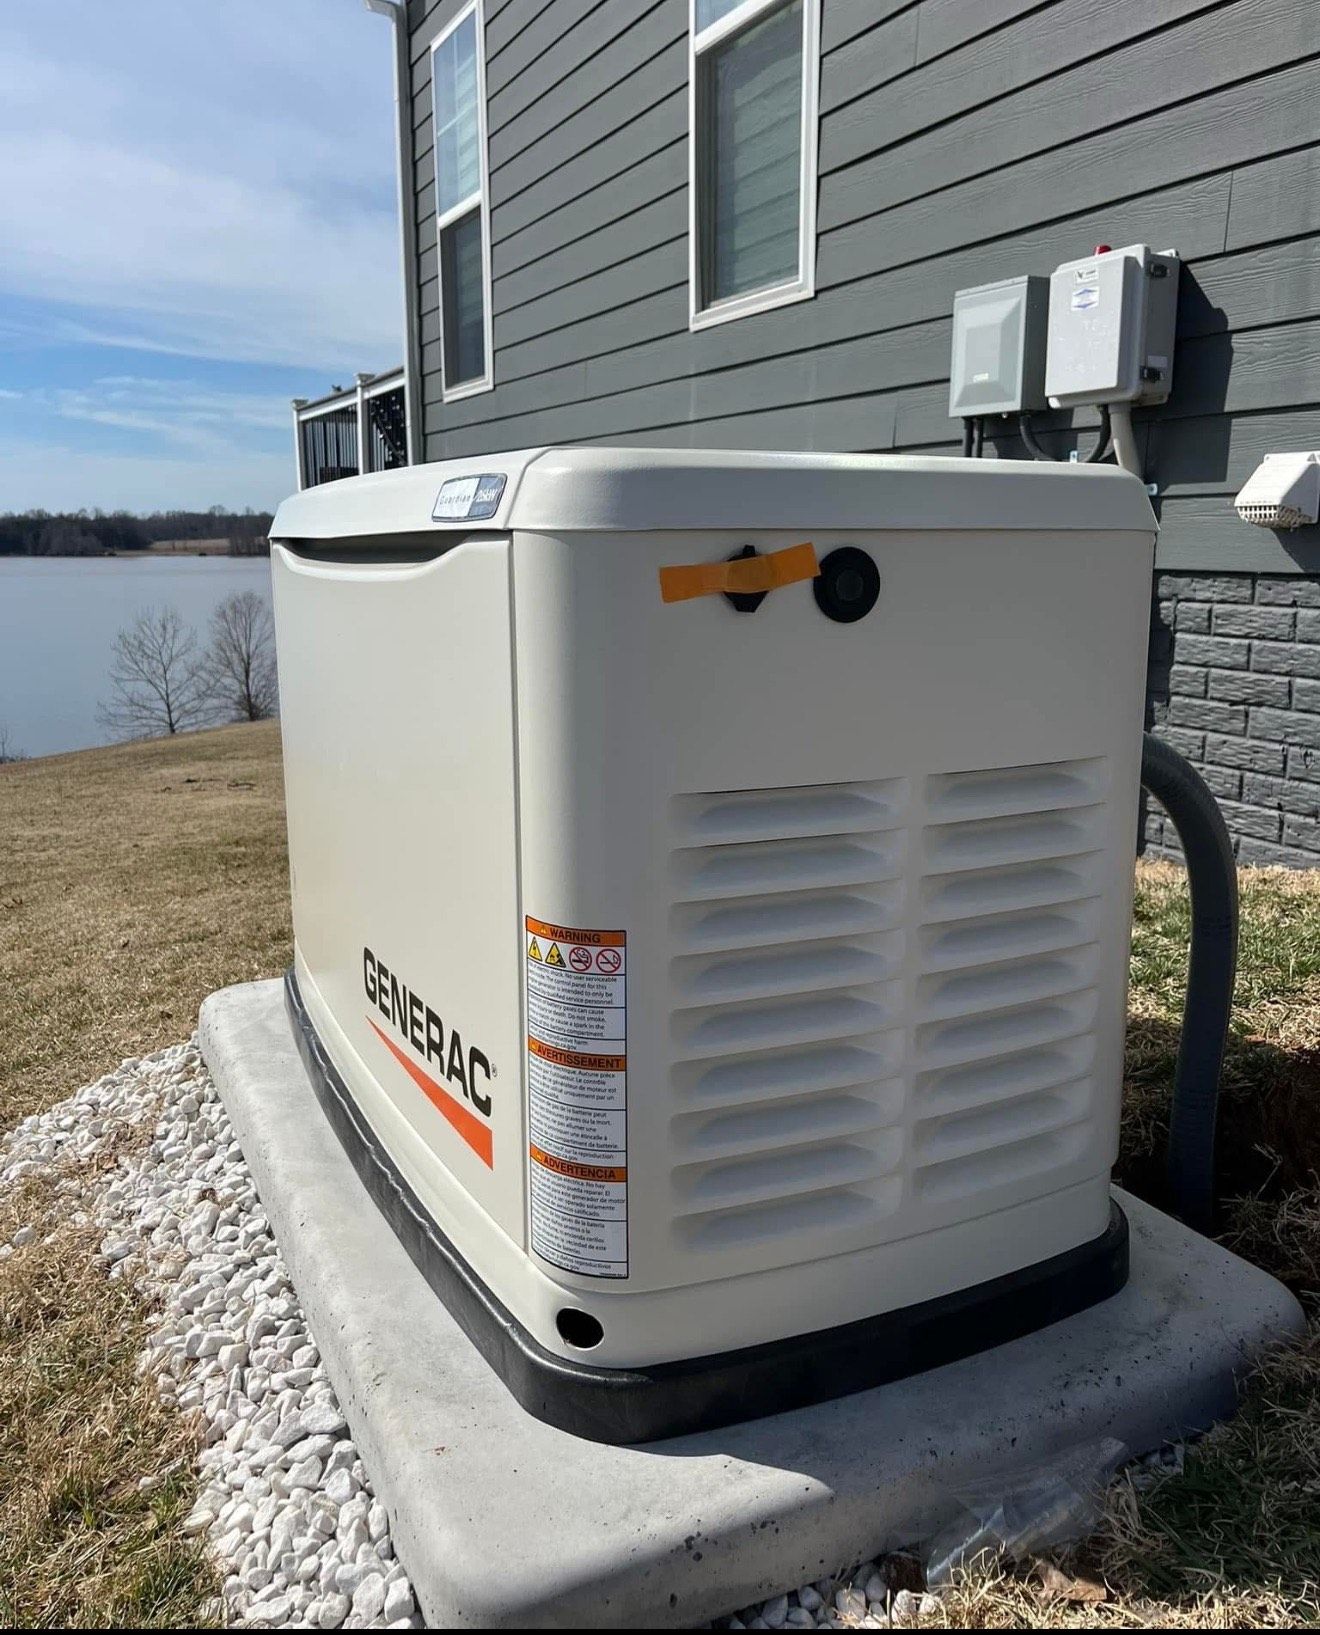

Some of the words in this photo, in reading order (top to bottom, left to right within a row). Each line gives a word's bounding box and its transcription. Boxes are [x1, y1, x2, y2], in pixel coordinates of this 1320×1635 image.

[550, 928, 600, 943] WARNING
[364, 947, 492, 1117] GENERAC
[538, 1046, 620, 1068] AVERTISSEMENT
[544, 1156, 616, 1178] ADVERTENCIA
